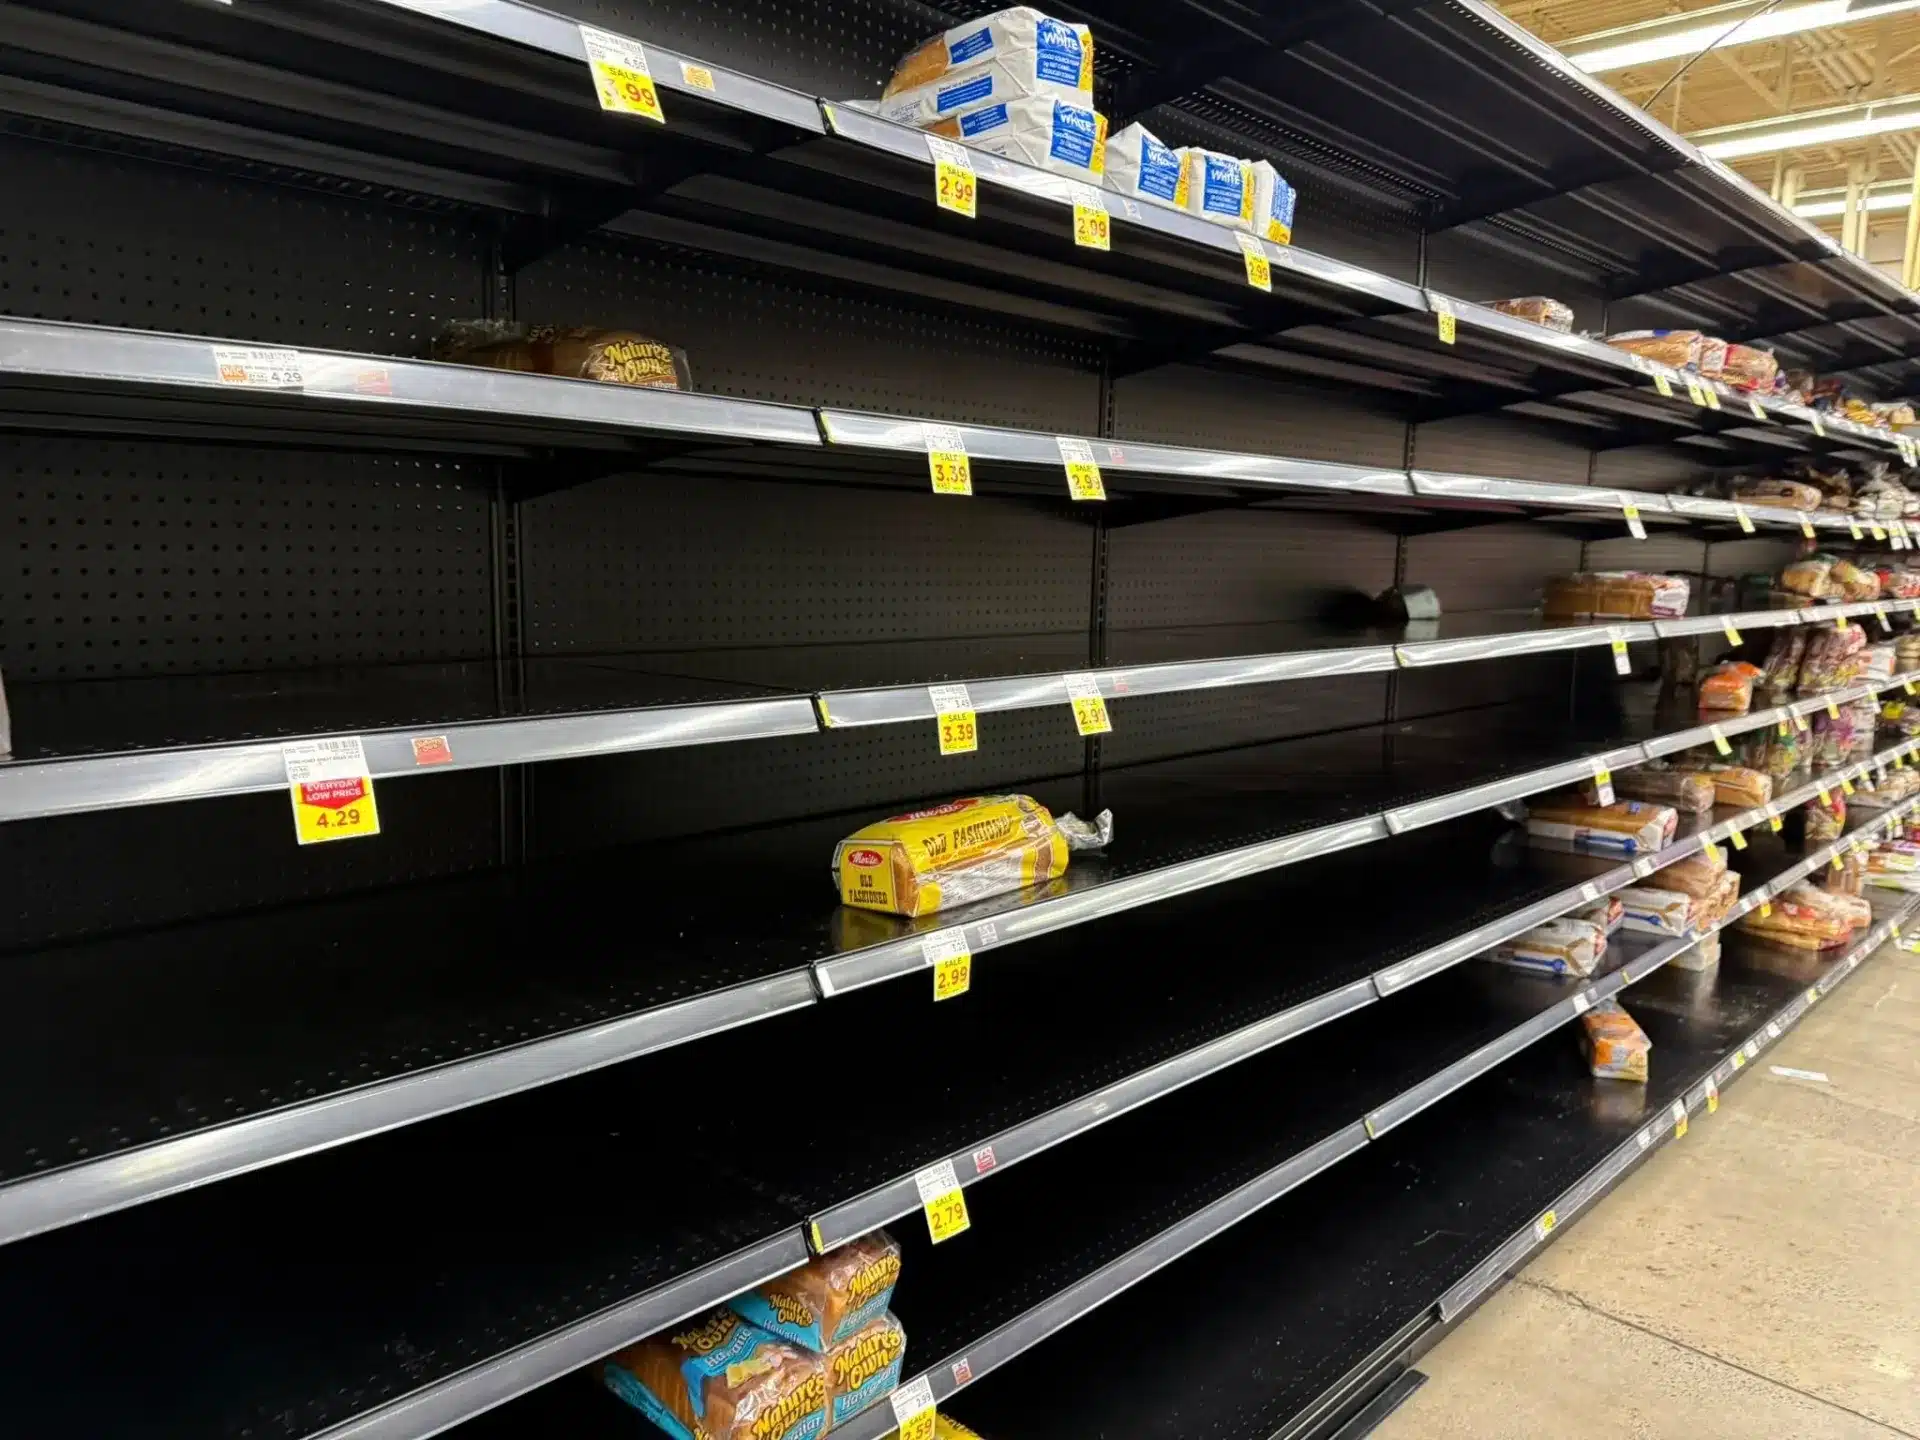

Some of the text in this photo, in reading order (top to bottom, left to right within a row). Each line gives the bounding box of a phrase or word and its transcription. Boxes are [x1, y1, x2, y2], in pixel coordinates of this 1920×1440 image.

[1043, 31, 1079, 52] WHITE
[608, 66, 641, 83] SALE
[1060, 113, 1094, 134] WHITE
[1211, 168, 1241, 186] WHITE
[940, 176, 973, 202] 2.99
[604, 341, 672, 369] Nature's
[271, 372, 303, 384] 4.29
[617, 358, 662, 383] Own
[935, 464, 967, 483] 3.39
[948, 713, 967, 722] SALE
[943, 724, 973, 743] 3.39
[306, 778, 358, 792] EVERYDAY
[307, 788, 361, 802] LOW PRICE
[316, 809, 360, 829] 4.29
[922, 832, 947, 857] OLD
[859, 874, 873, 888] OLD
[848, 889, 888, 905] FASHIONED
[945, 957, 963, 968] SALE
[938, 966, 968, 989] 2.99
[935, 1193, 954, 1207] SALE
[932, 1202, 963, 1230] 2.79
[846, 1253, 901, 1304] Nature's
[834, 1330, 901, 1386] Nature's
[850, 1348, 889, 1390] Own
[751, 1373, 825, 1438] Nature's
[909, 1411, 928, 1427] SALE
